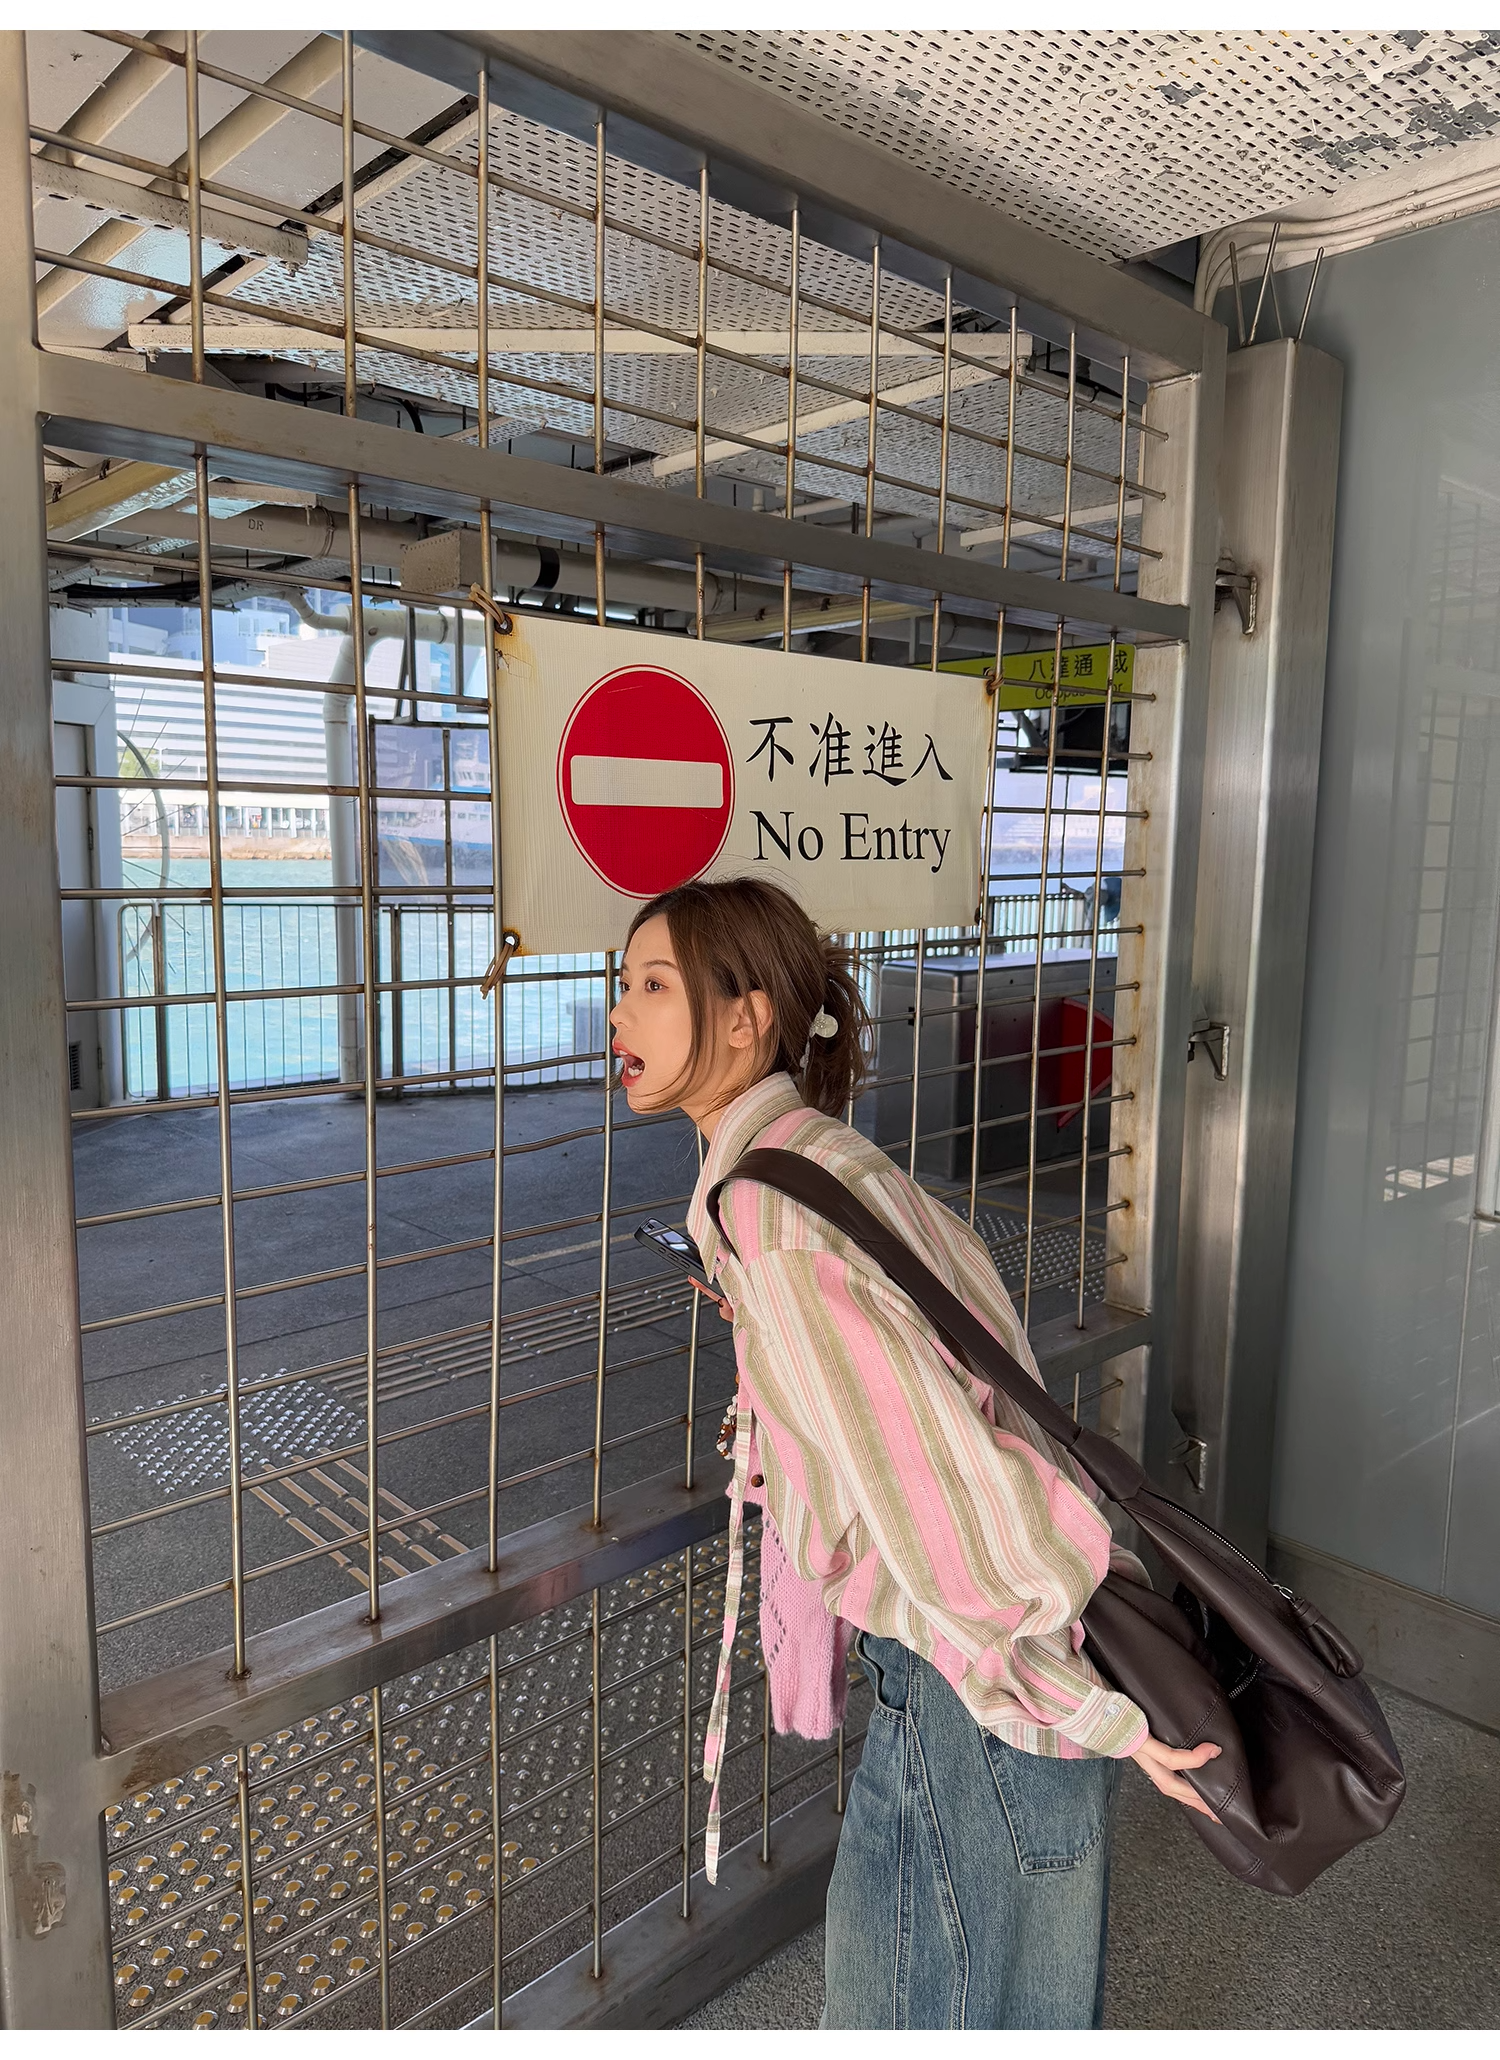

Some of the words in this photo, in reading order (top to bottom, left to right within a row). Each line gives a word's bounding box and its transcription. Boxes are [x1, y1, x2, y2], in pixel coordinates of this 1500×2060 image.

[248, 518, 265, 532] DR
[746, 711, 954, 787] 不准進入
[749, 810, 824, 861] No
[839, 812, 951, 873] Entry
